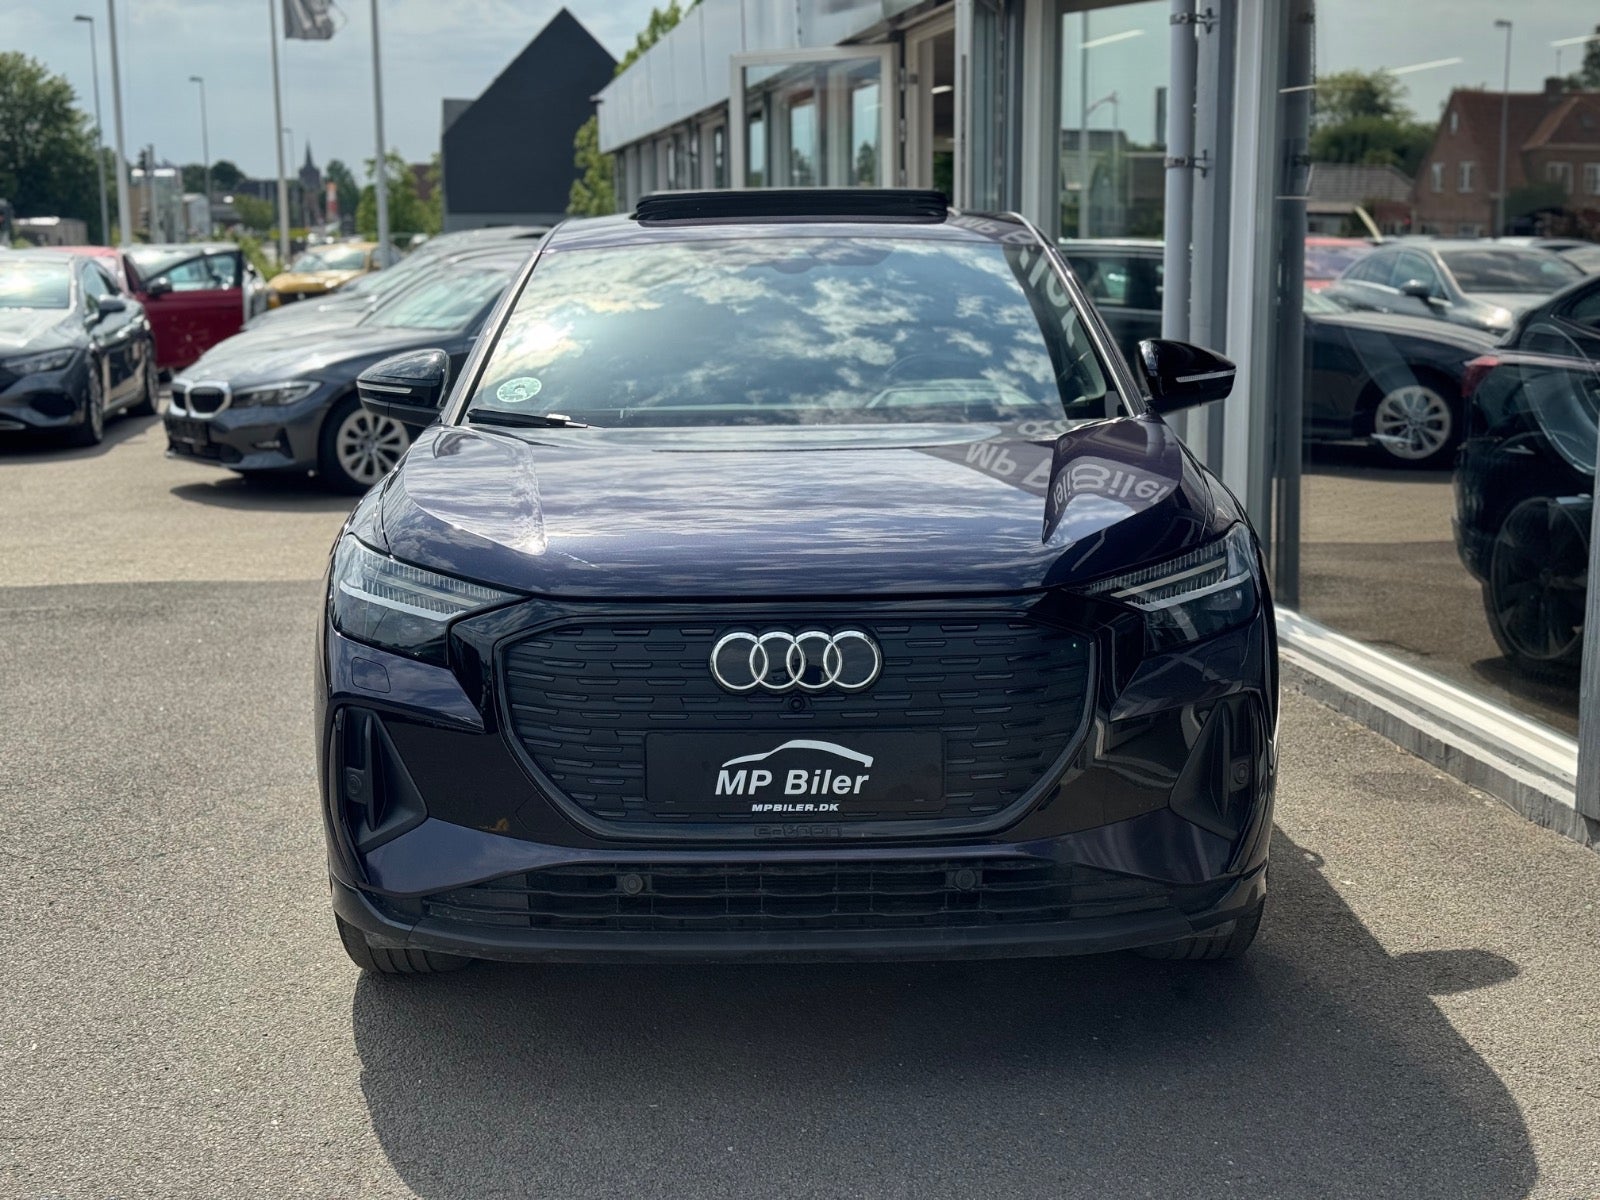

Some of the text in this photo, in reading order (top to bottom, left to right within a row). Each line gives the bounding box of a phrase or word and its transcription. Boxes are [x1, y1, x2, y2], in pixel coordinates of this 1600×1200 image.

[715, 769, 870, 796] MP Biler
[751, 803, 840, 812] MPBILER.DK
